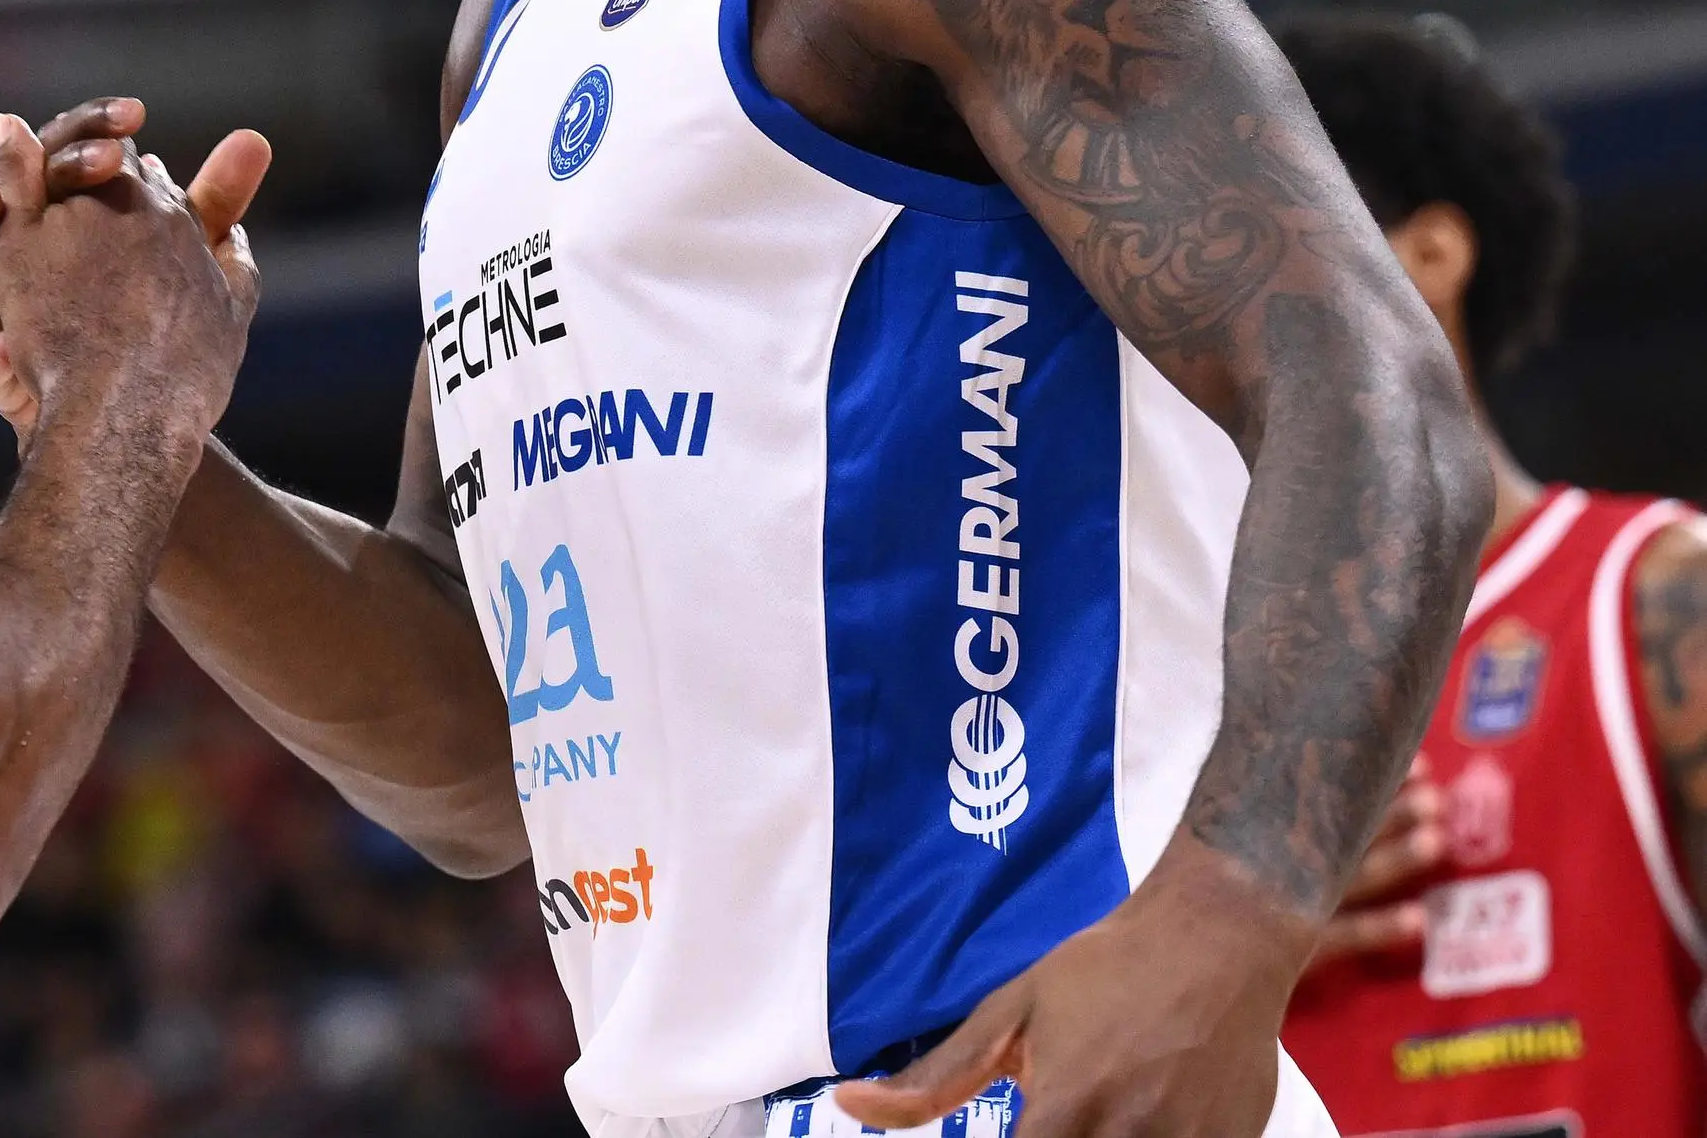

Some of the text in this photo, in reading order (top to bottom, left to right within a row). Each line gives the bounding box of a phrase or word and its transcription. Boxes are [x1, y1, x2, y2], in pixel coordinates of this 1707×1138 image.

[553, 144, 591, 170] BRESCIA
[481, 229, 551, 286] METROLOGIA
[427, 257, 567, 405] TECHNE
[953, 270, 1029, 693] GERMANI
